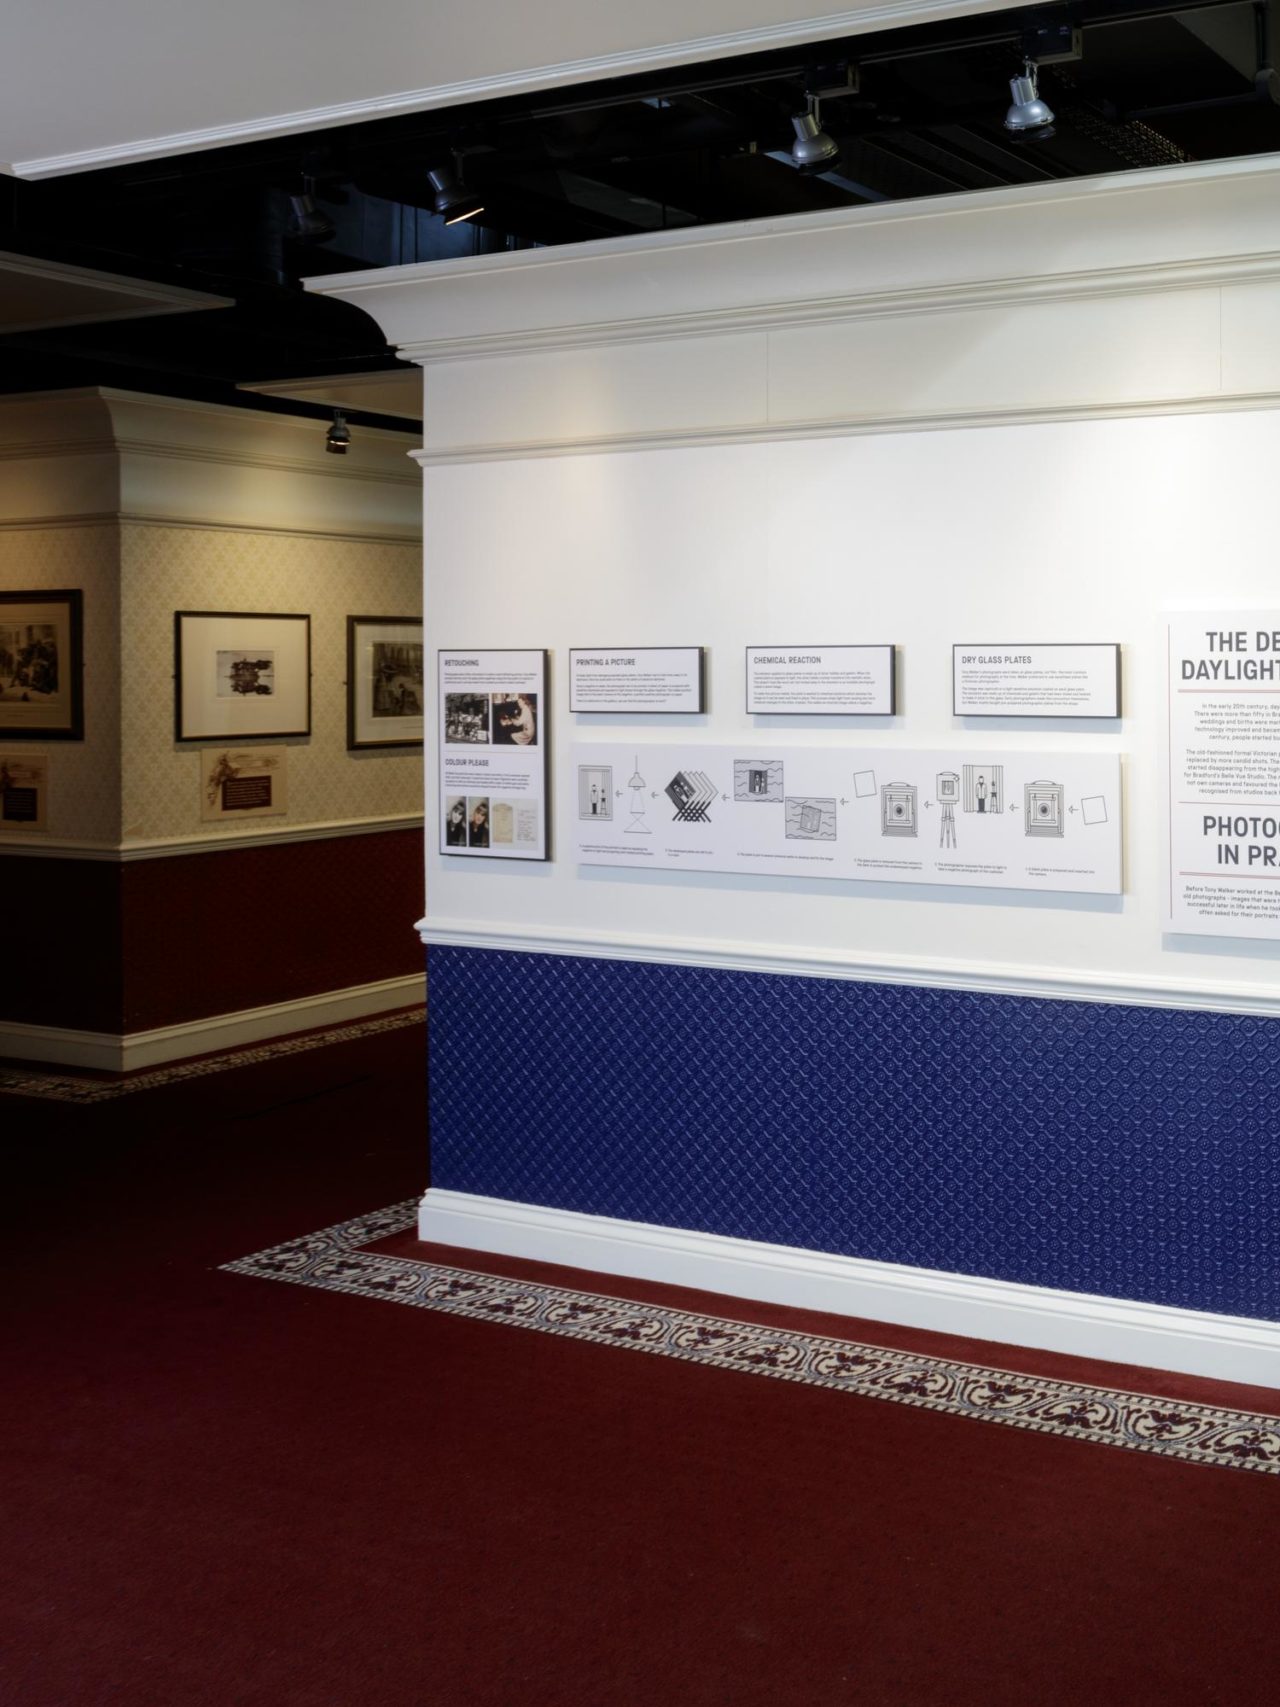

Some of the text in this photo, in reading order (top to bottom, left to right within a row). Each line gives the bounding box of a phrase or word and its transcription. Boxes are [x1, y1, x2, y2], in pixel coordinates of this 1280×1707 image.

[1206, 631, 1247, 652] THE
[611, 658, 635, 666] PICTURE
[754, 656, 821, 664] CHEMICAL REACTION
[962, 656, 1032, 664] DRY GLASS PLATES
[445, 758, 467, 766] COLOUR
[1217, 844, 1239, 864] IN
